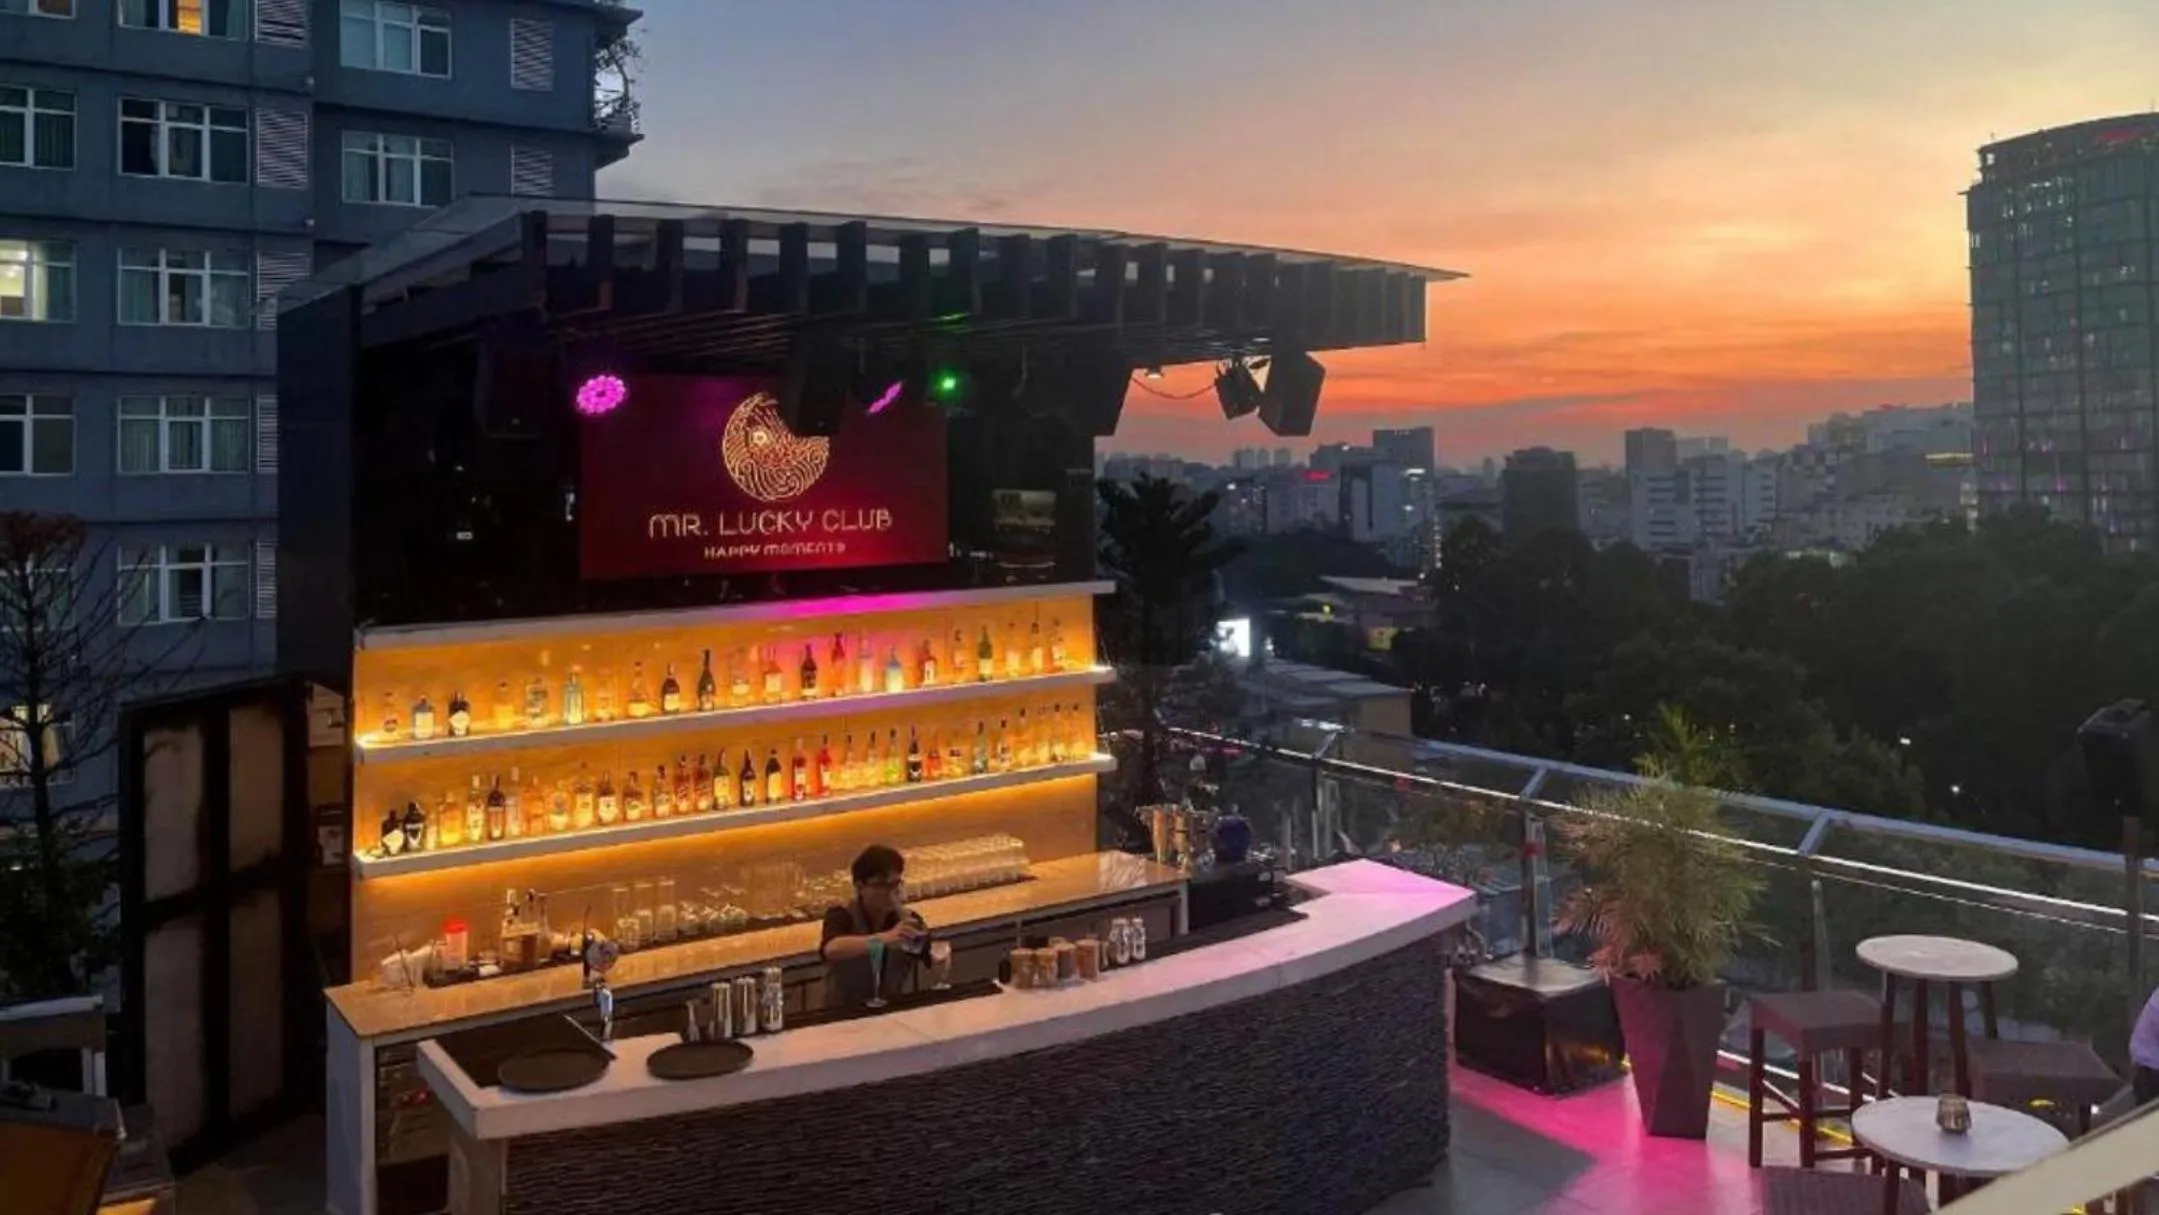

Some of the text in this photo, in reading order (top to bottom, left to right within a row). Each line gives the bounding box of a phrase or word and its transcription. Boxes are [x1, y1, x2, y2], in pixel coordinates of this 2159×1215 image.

[649, 508, 893, 539] MR. LUCKY CLUB
[704, 543, 761, 560] HAPPY
